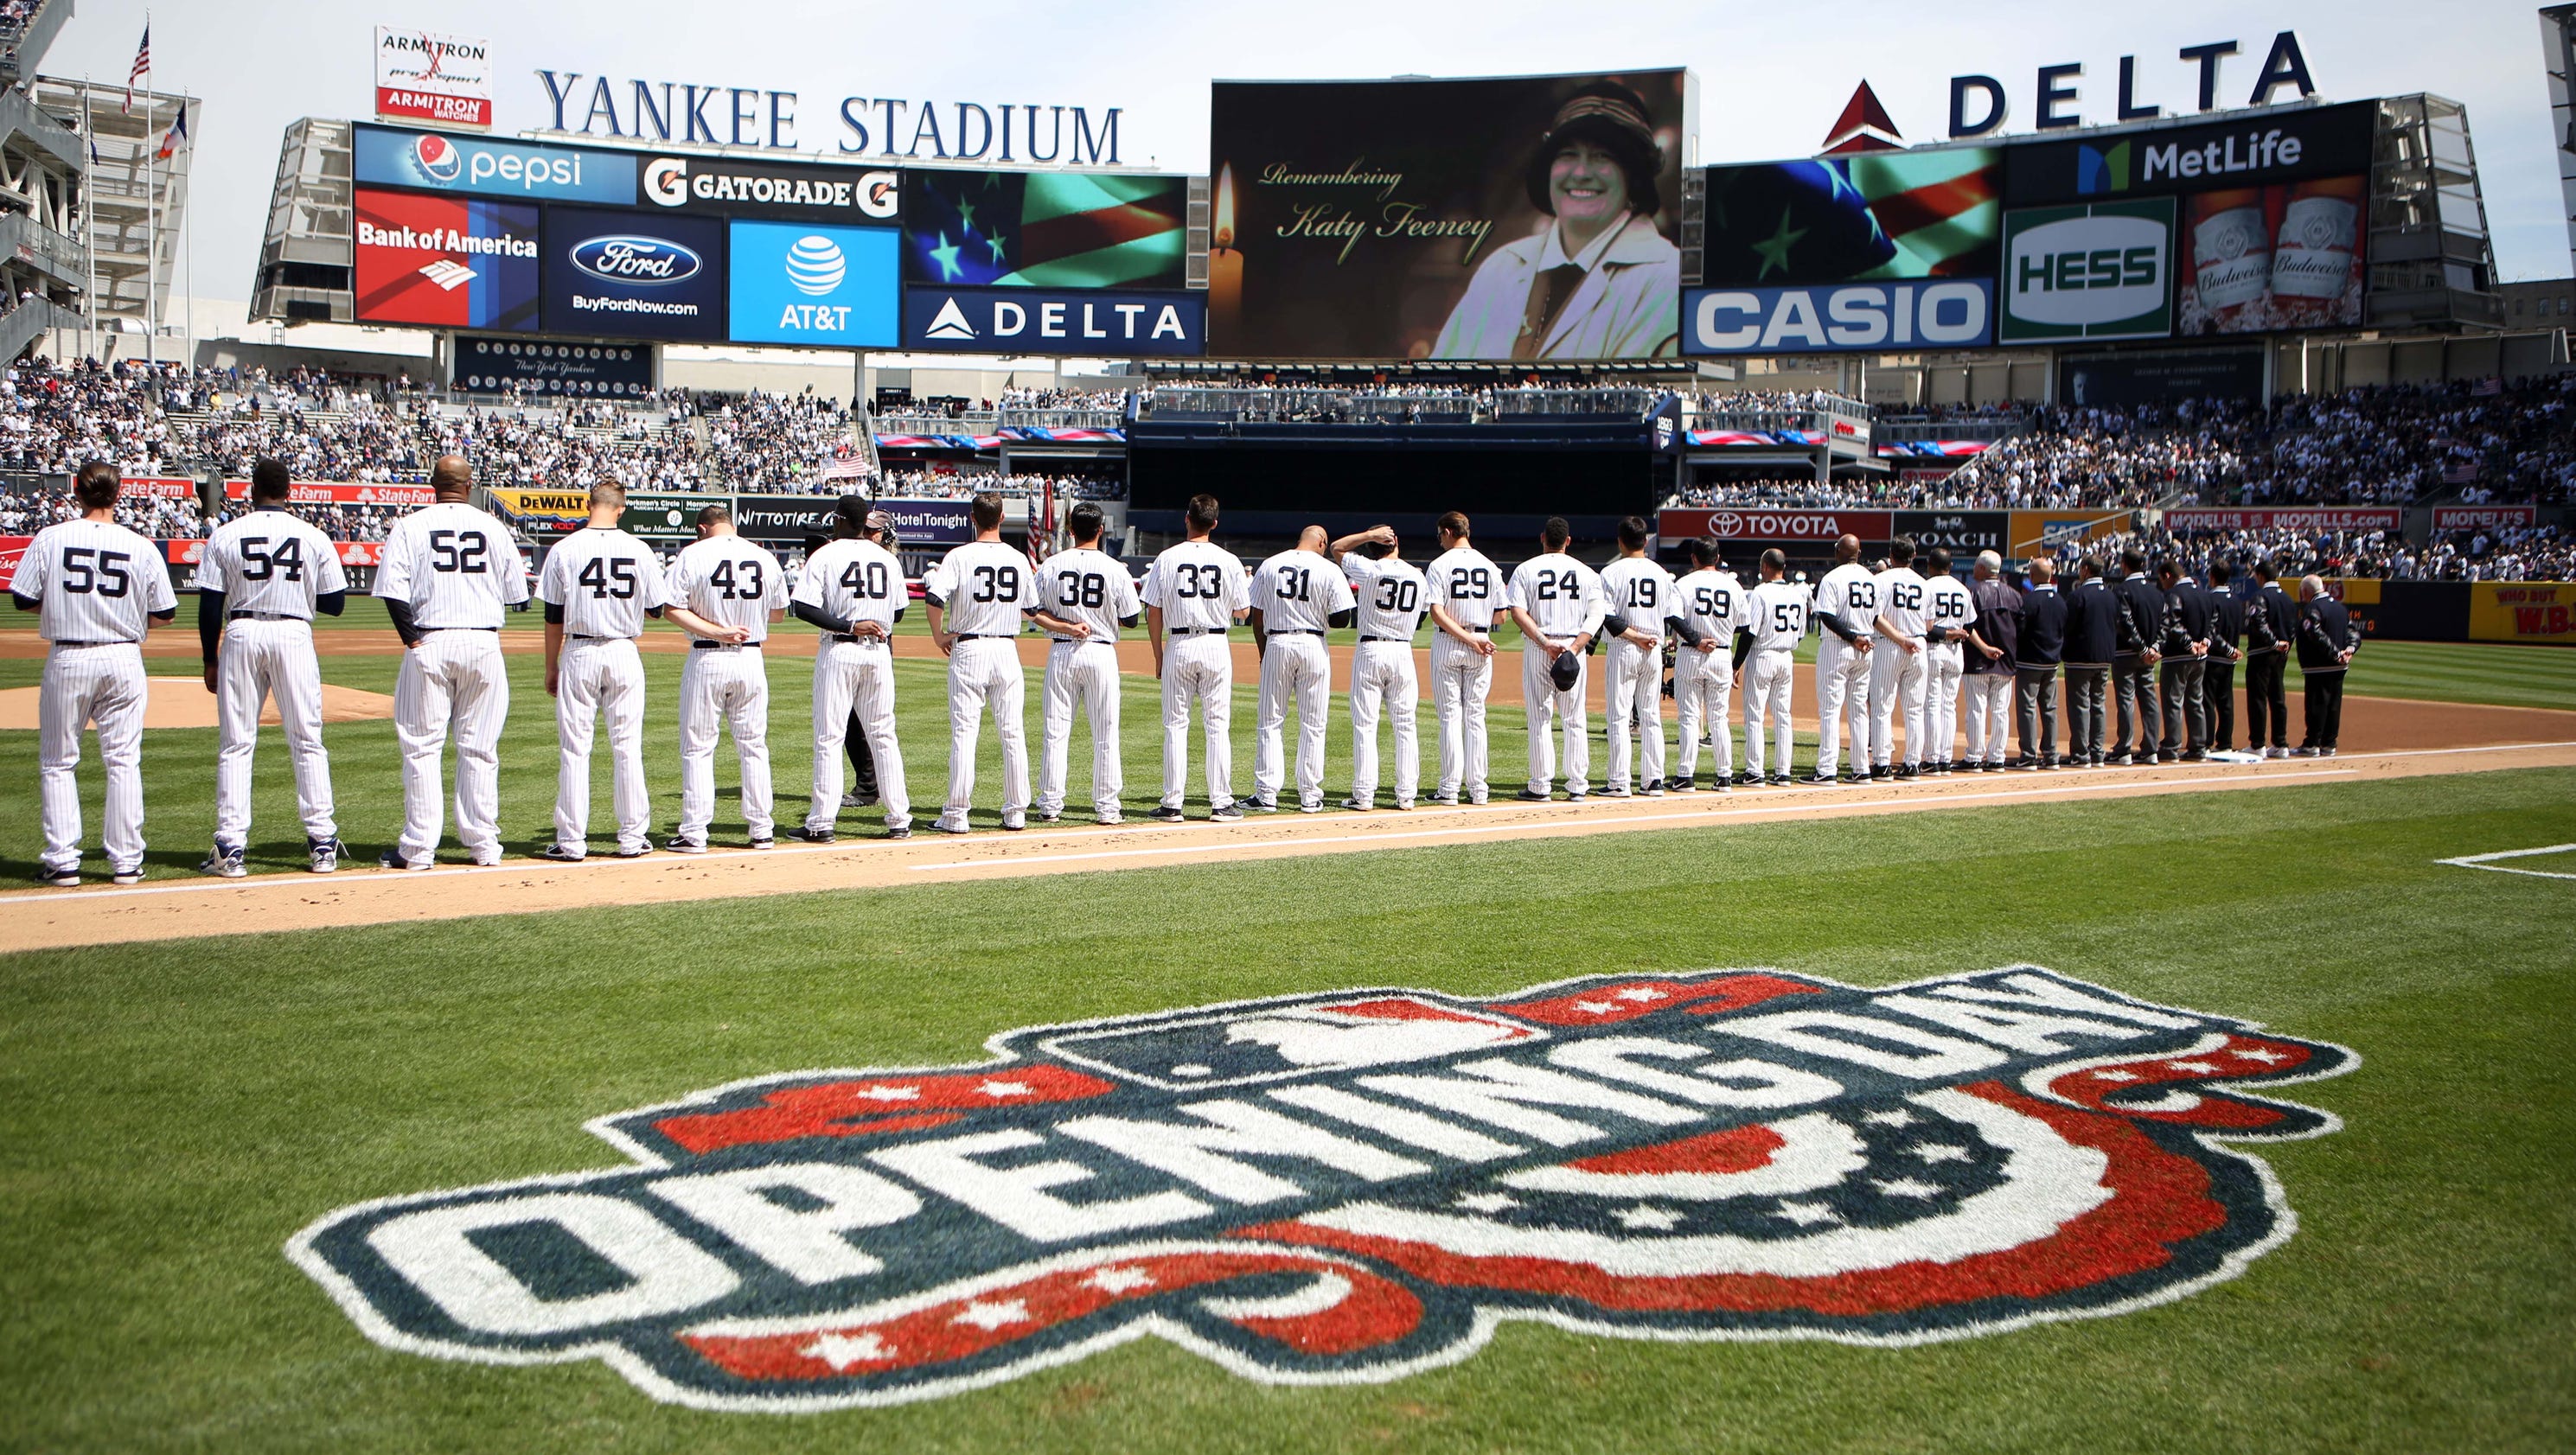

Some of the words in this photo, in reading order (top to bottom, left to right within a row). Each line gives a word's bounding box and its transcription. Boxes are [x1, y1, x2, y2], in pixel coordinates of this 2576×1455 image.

[383, 35, 485, 60] ARMITRON
[1949, 29, 2317, 137] DELTA
[388, 91, 481, 114] ARMITRON
[433, 109, 479, 123] WATCHES
[534, 69, 799, 149] YANKEE
[839, 96, 1123, 165] STADIUM
[470, 152, 581, 189] pepsi
[2143, 129, 2302, 182] MetLife
[693, 177, 851, 207] GATORADE
[1258, 156, 1403, 202] Remembering
[358, 221, 419, 250] Bank
[419, 228, 444, 251] of
[444, 228, 538, 258] America
[1277, 203, 1368, 265] Katy
[1375, 201, 1493, 265] Feeney
[597, 240, 677, 279] Ford
[2019, 246, 2157, 293] HESS
[572, 295, 698, 316] BuyFordNow.com
[779, 304, 851, 331] AT&T
[994, 301, 1186, 341] DELTA
[1697, 282, 1985, 348] CASIO
[515, 359, 534, 371] New
[536, 360, 558, 376] York
[559, 361, 596, 377] Yankees
[962, 463, 999, 474] TERRA
[660, 499, 681, 507] Circle
[2272, 512, 2394, 528] MODELLS.com
[527, 521, 577, 531] FLEXVOLT
[633, 524, 651, 533] What
[653, 525, 678, 533] Matters
[1747, 514, 1840, 536] TOYOTA
[240, 537, 304, 582] 54
[430, 530, 488, 573] 52
[63, 546, 131, 597] 55
[578, 557, 636, 599] 45
[710, 558, 764, 599] 43
[840, 560, 888, 599] 40
[973, 565, 1020, 603] 39
[1177, 563, 1222, 598] 33
[1275, 565, 1311, 603] 31
[1450, 567, 1490, 600] 29
[1537, 569, 1580, 601] 24
[1058, 571, 1105, 609] 38
[1375, 577, 1418, 613] 30
[1627, 577, 1657, 609] 19
[1694, 586, 1730, 620] 59
[1848, 581, 1876, 609] 63
[1892, 582, 1923, 610] 62
[1935, 592, 1965, 618] 56
[2496, 589, 2527, 603] WHO
[2529, 589, 2557, 603] BUT
[1774, 603, 1801, 633] 53
[366, 1036, 1845, 1335] OPENING
[1710, 968, 2214, 1080] DAY
